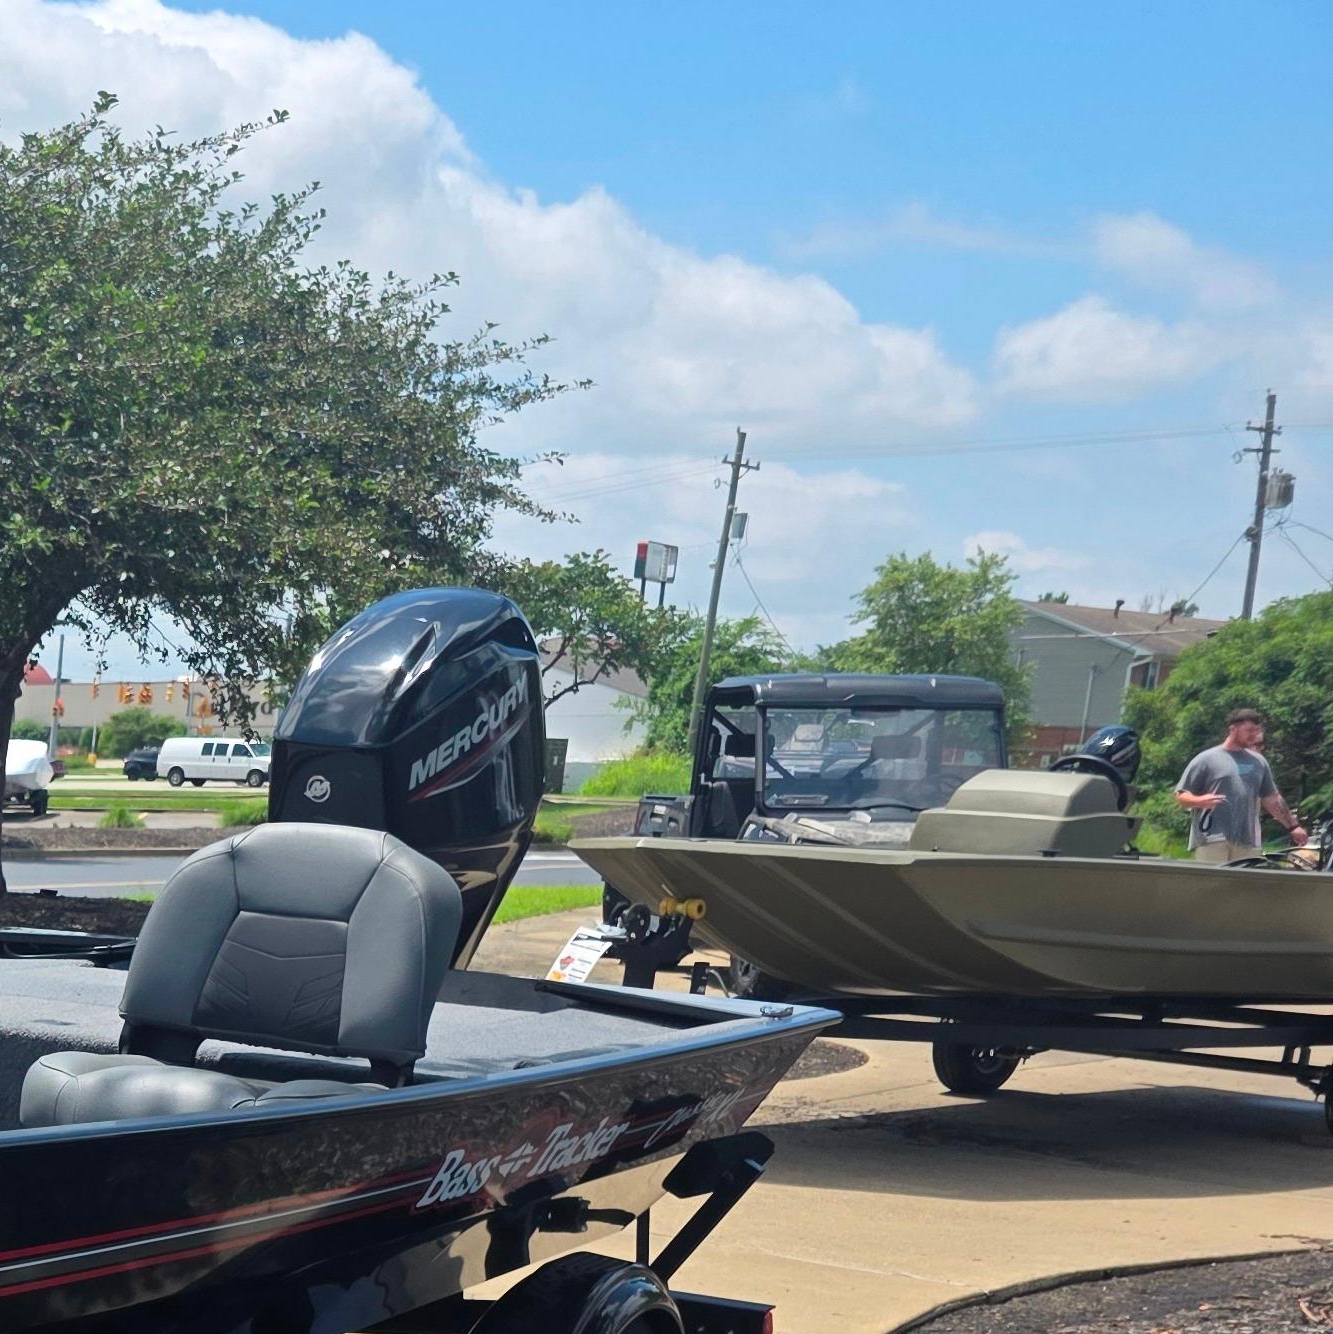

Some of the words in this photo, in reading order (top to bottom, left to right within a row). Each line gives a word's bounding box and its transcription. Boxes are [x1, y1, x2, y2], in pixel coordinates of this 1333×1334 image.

[408, 670, 529, 791] MERCURY
[415, 1150, 503, 1208] Bass
[527, 1116, 631, 1178] Tracker
